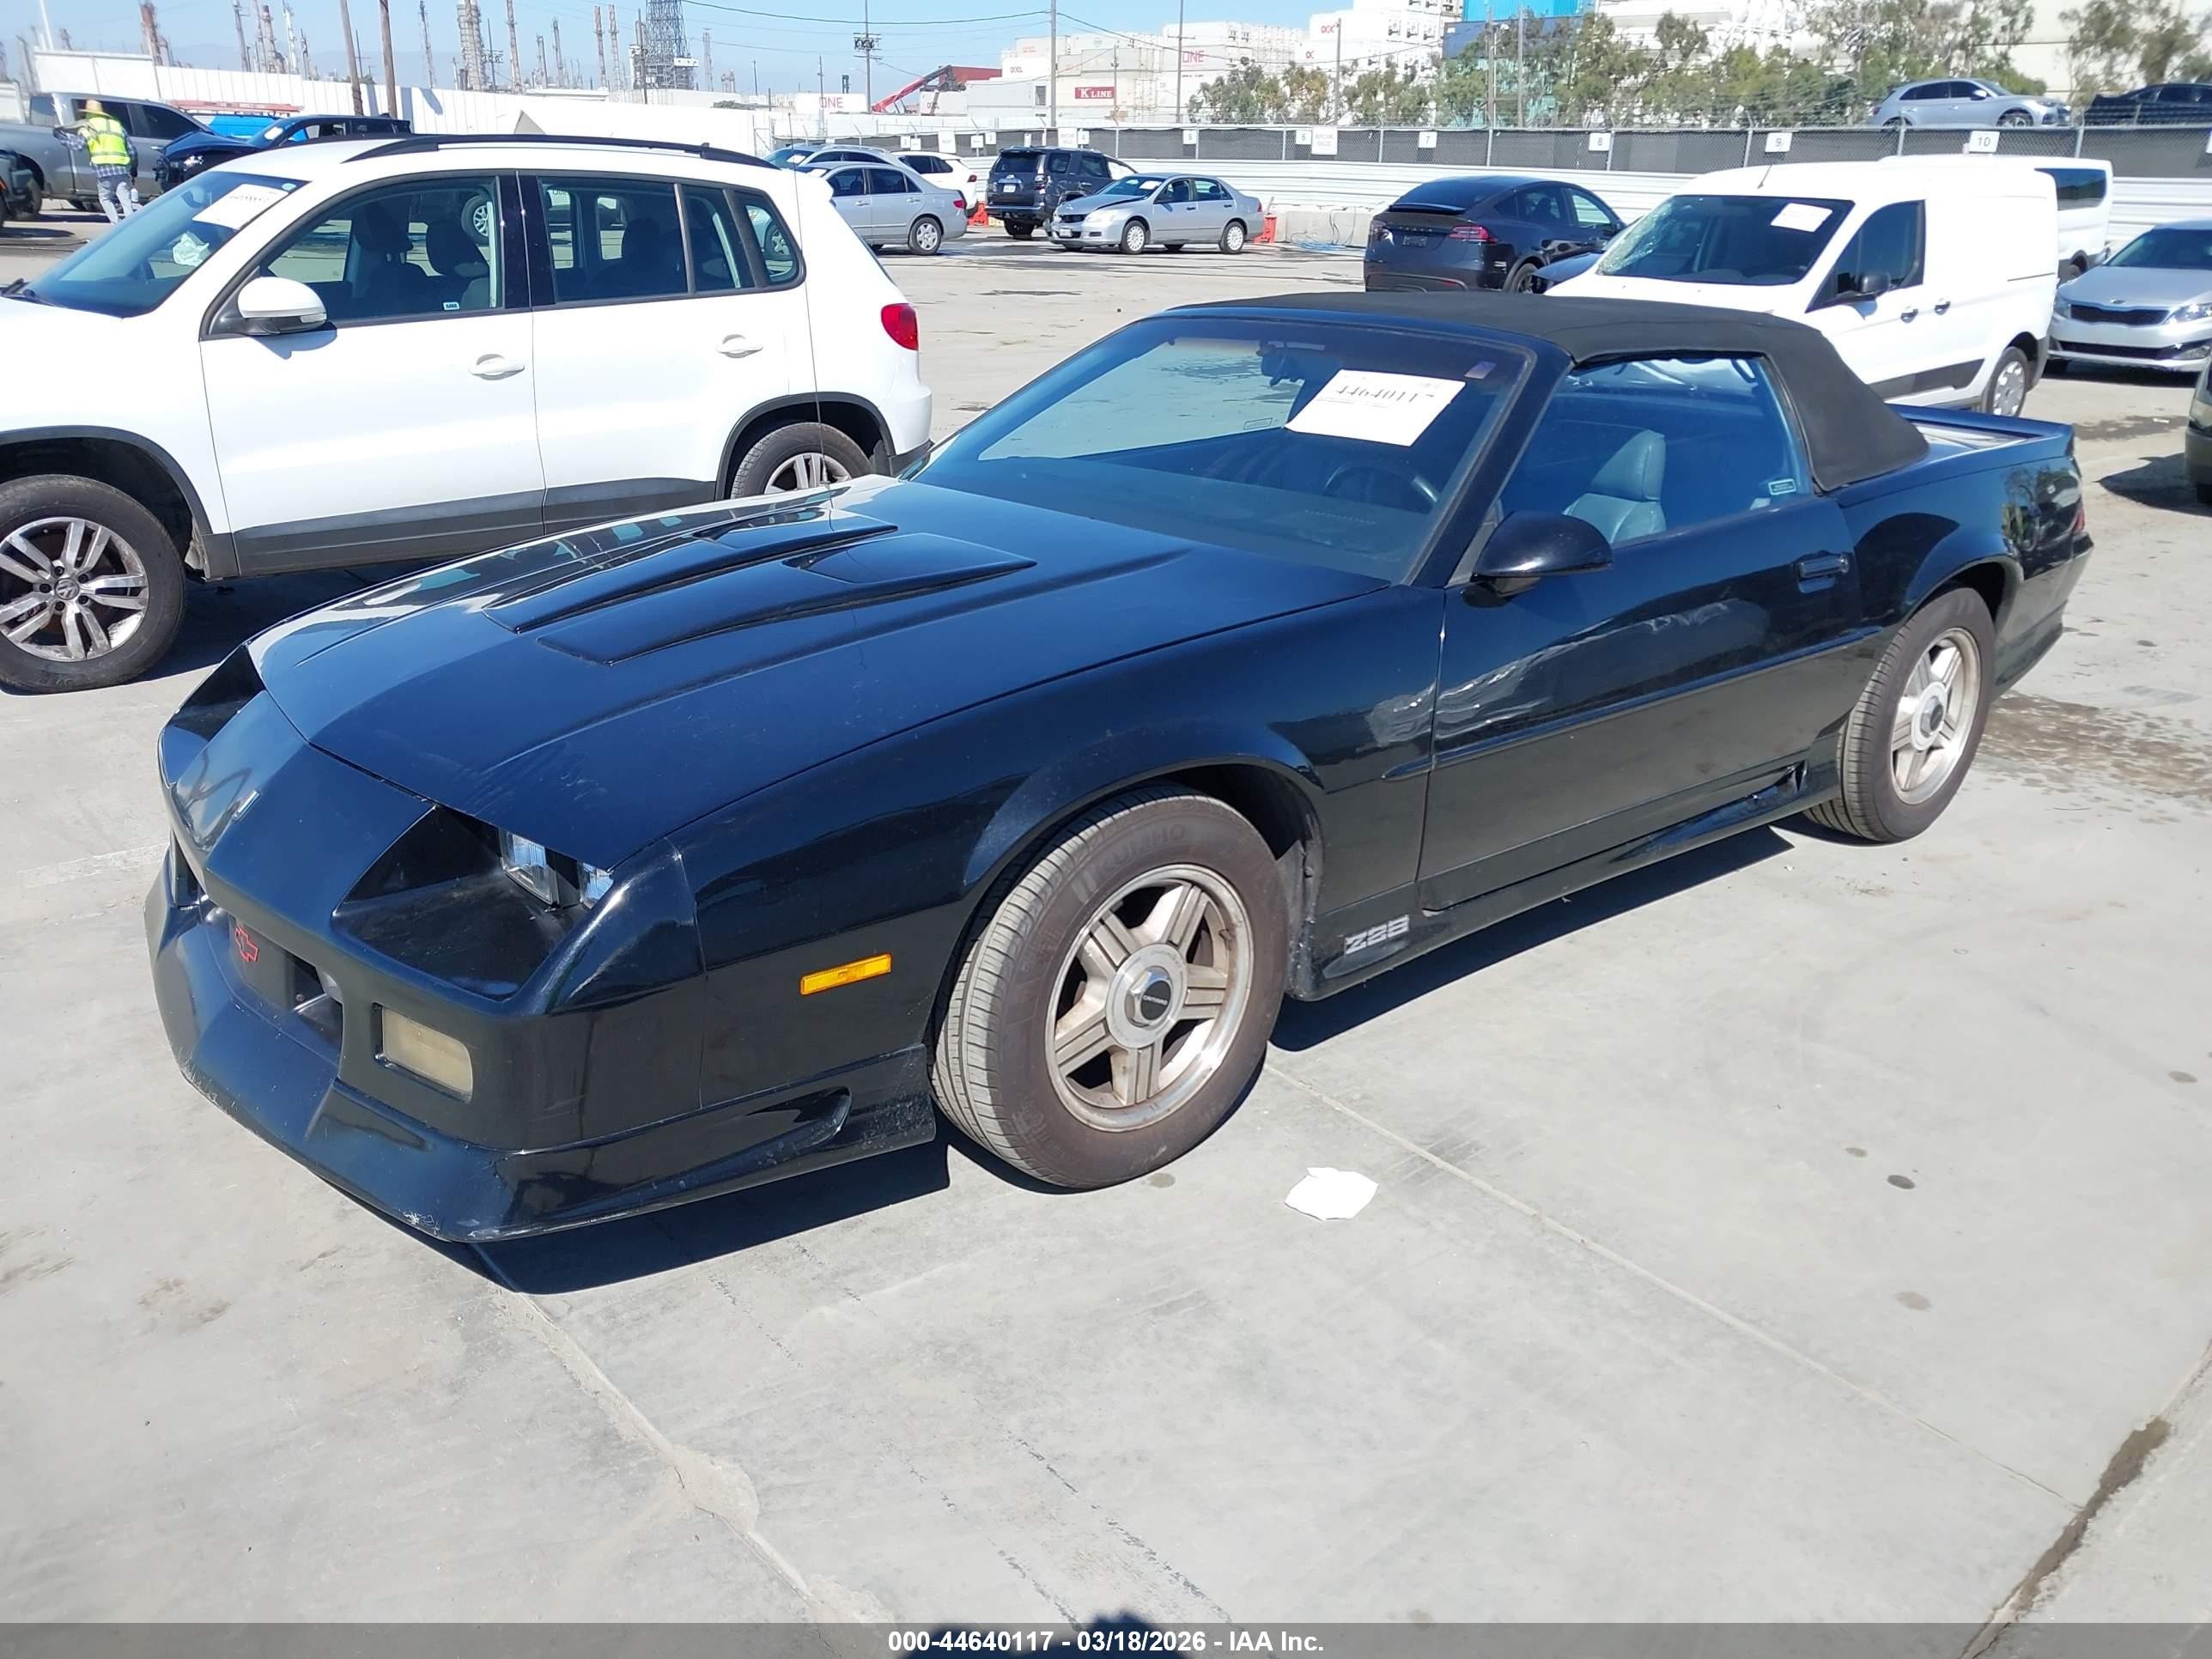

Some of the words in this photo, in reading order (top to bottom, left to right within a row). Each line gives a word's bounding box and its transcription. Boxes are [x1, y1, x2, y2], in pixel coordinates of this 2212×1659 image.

[1079, 88, 1091, 98] K
[818, 96, 843, 108] ONE
[1301, 133, 1306, 142] 6
[1425, 136, 1431, 144] 7
[1597, 137, 1603, 147] 8
[1775, 137, 1783, 148] 9
[1978, 137, 1991, 148] 10
[1345, 914, 1409, 955] Z28
